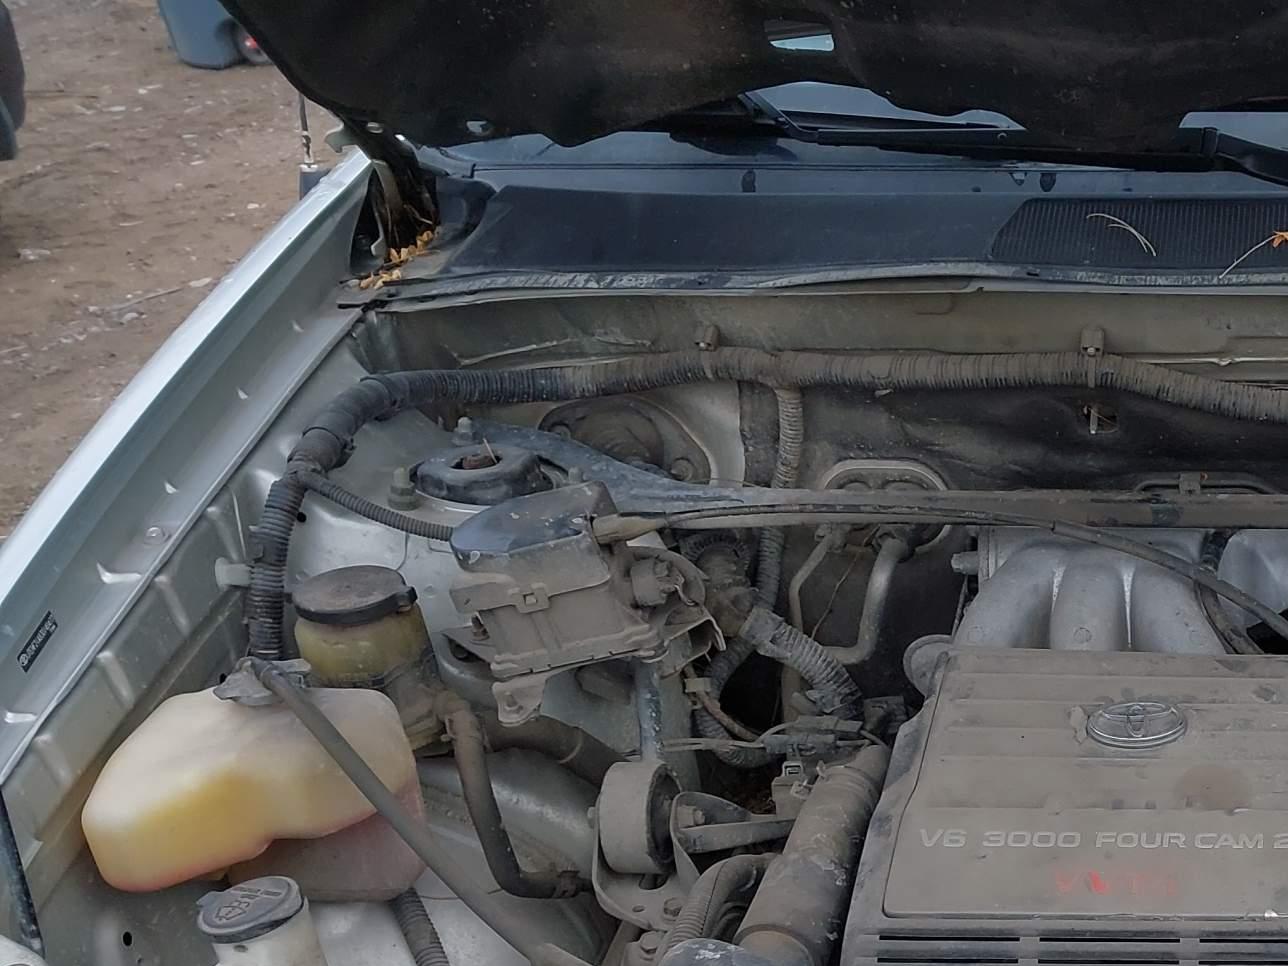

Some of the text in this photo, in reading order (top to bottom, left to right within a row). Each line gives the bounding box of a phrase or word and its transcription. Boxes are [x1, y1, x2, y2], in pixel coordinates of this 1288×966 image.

[920, 828, 968, 848] V6
[982, 831, 1081, 848] 3000
[1095, 831, 1187, 849] FOUR
[1194, 832, 1264, 849] CAM
